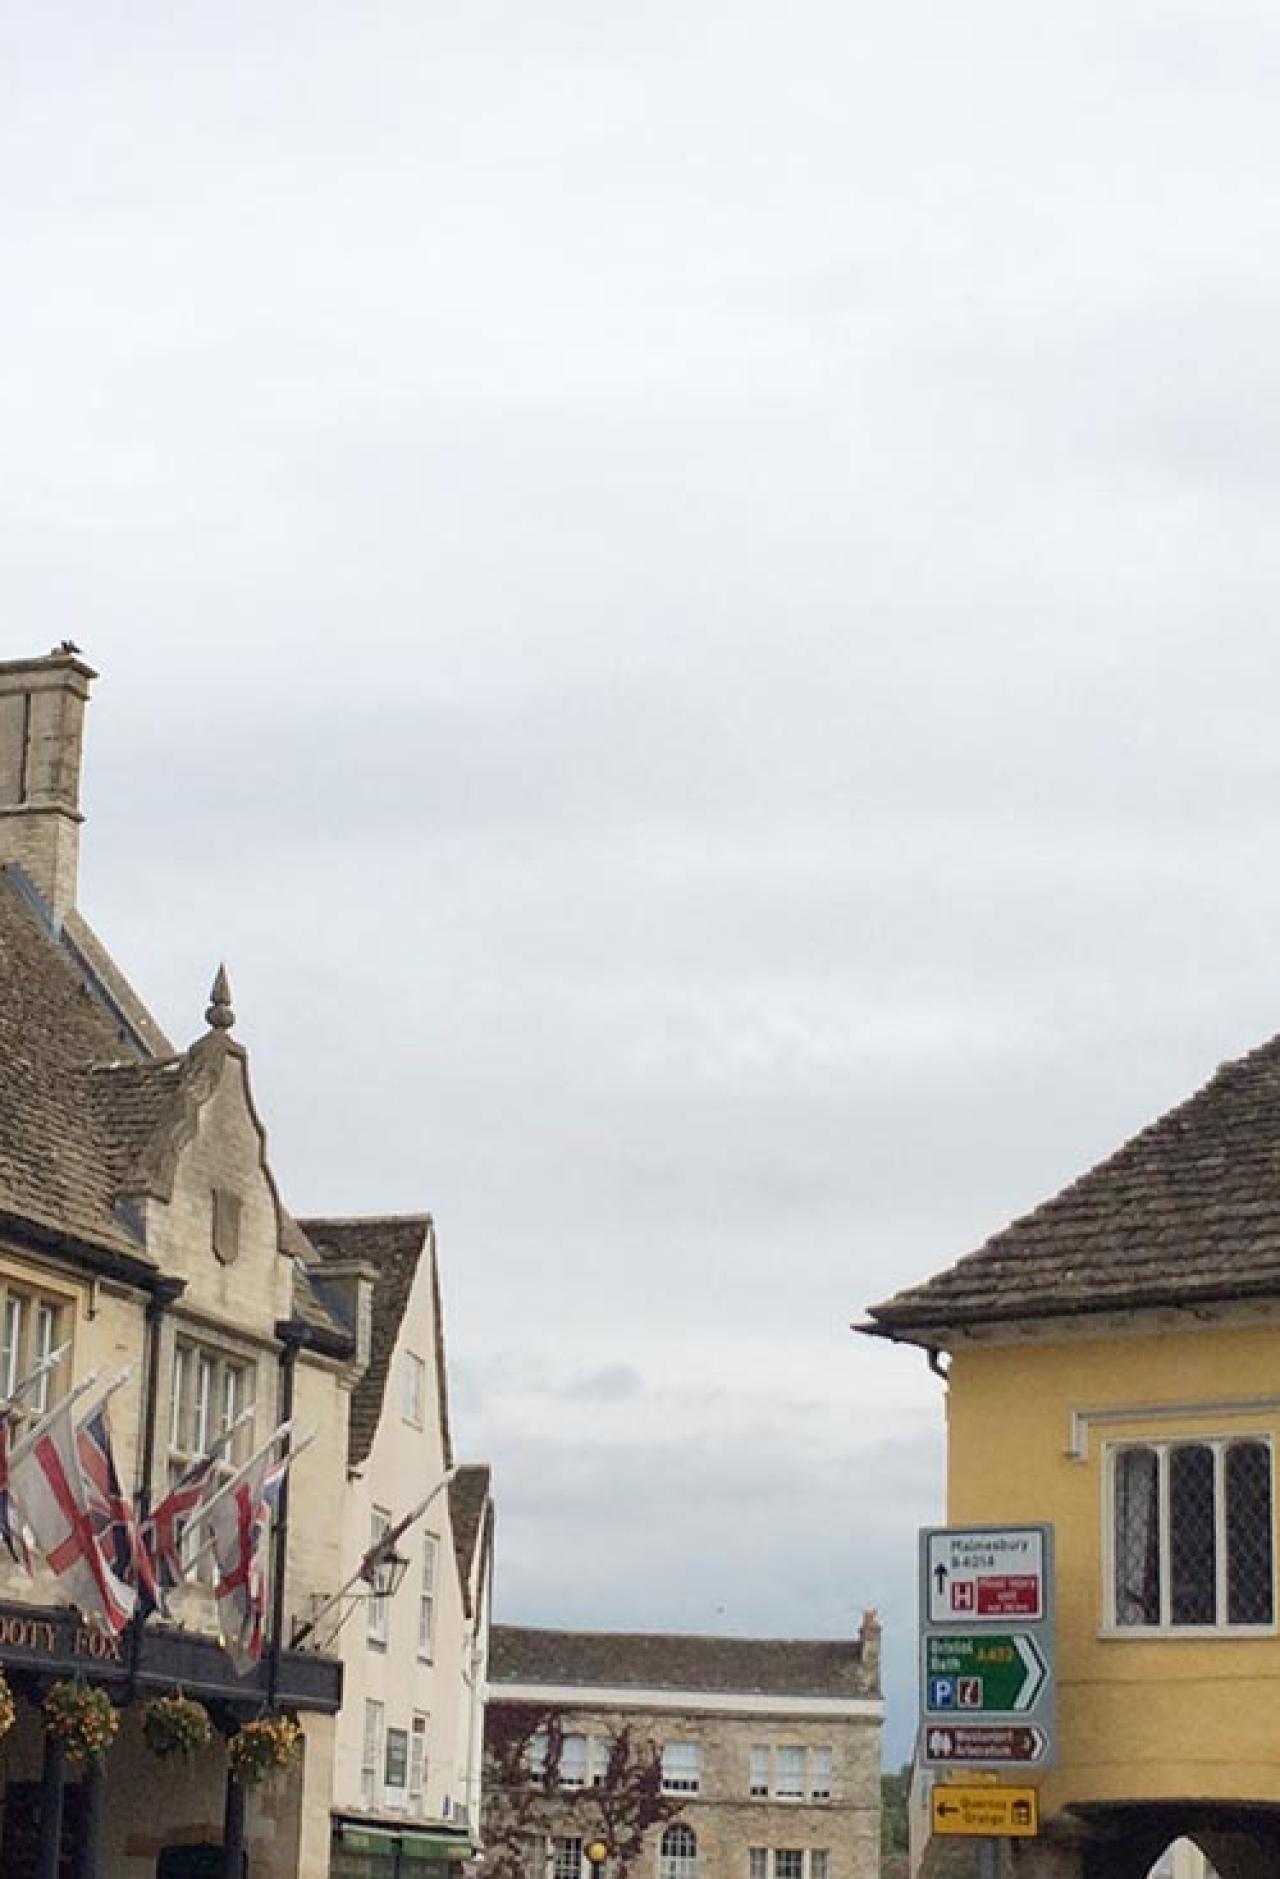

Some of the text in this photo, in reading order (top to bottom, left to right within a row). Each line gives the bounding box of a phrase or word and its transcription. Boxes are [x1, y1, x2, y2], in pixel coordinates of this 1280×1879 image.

[954, 1582, 972, 1608] H
[73, 1627, 121, 1662] FOX
[936, 1681, 952, 1706] P
